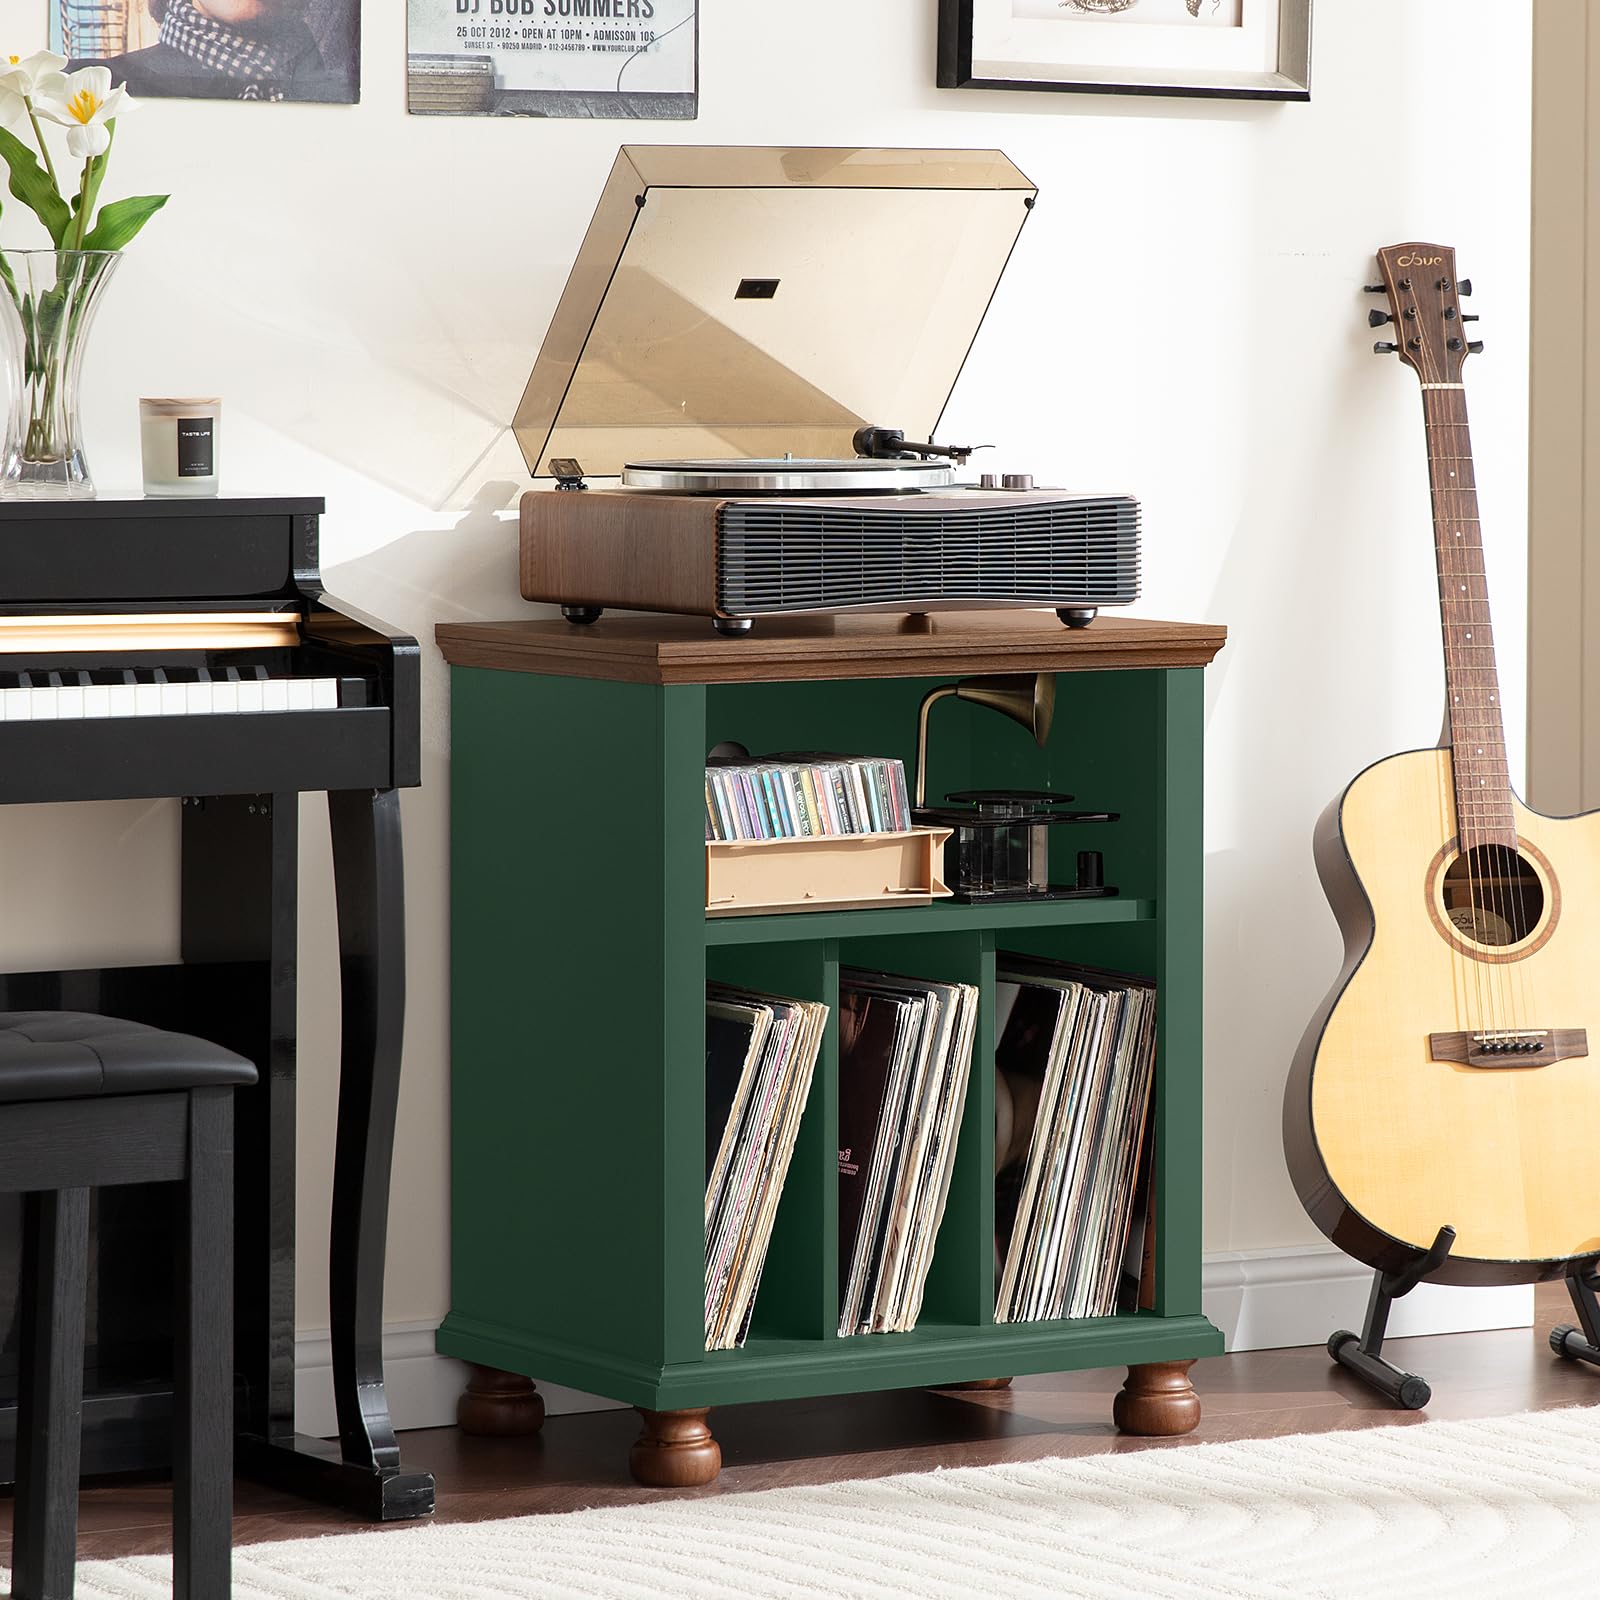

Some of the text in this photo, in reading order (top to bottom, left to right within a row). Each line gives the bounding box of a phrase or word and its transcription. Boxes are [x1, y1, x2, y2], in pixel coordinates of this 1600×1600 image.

[456, 26, 467, 37] 25
[470, 26, 487, 38] OCT
[489, 27, 511, 38] 2012
[522, 28, 544, 39] OPEN
[546, 28, 557, 39] AT
[560, 29, 582, 40] 10PM
[593, 30, 636, 41] ADMISSON
[464, 41, 485, 49] SUNSET
[486, 41, 495, 49] ST.
[502, 42, 520, 50] 90250
[521, 42, 542, 50] MADRID
